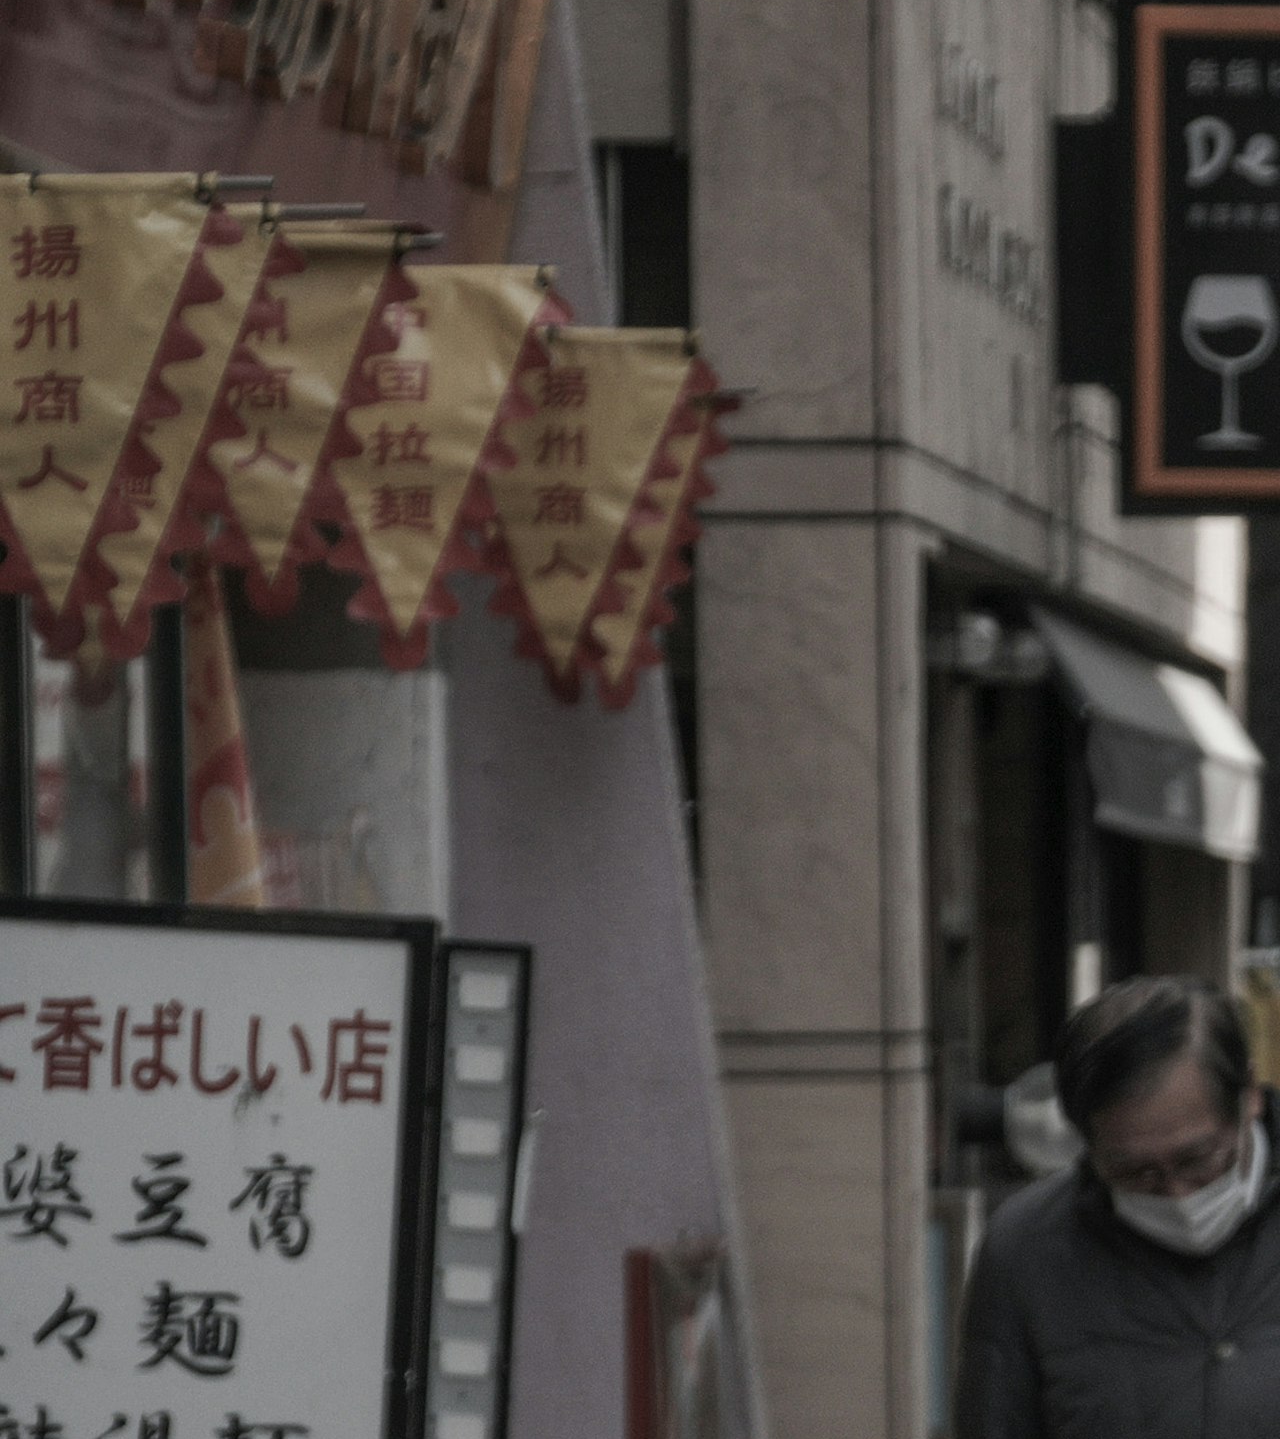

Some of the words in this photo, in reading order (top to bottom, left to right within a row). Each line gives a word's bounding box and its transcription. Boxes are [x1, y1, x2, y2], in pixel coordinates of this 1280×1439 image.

[11, 224, 89, 494] 揚州商人
[228, 294, 300, 472] 州商人
[534, 365, 587, 578] 揚州商人
[0, 1144, 316, 1258] 婆豆腐
[0, 1280, 241, 1376] 々麺
